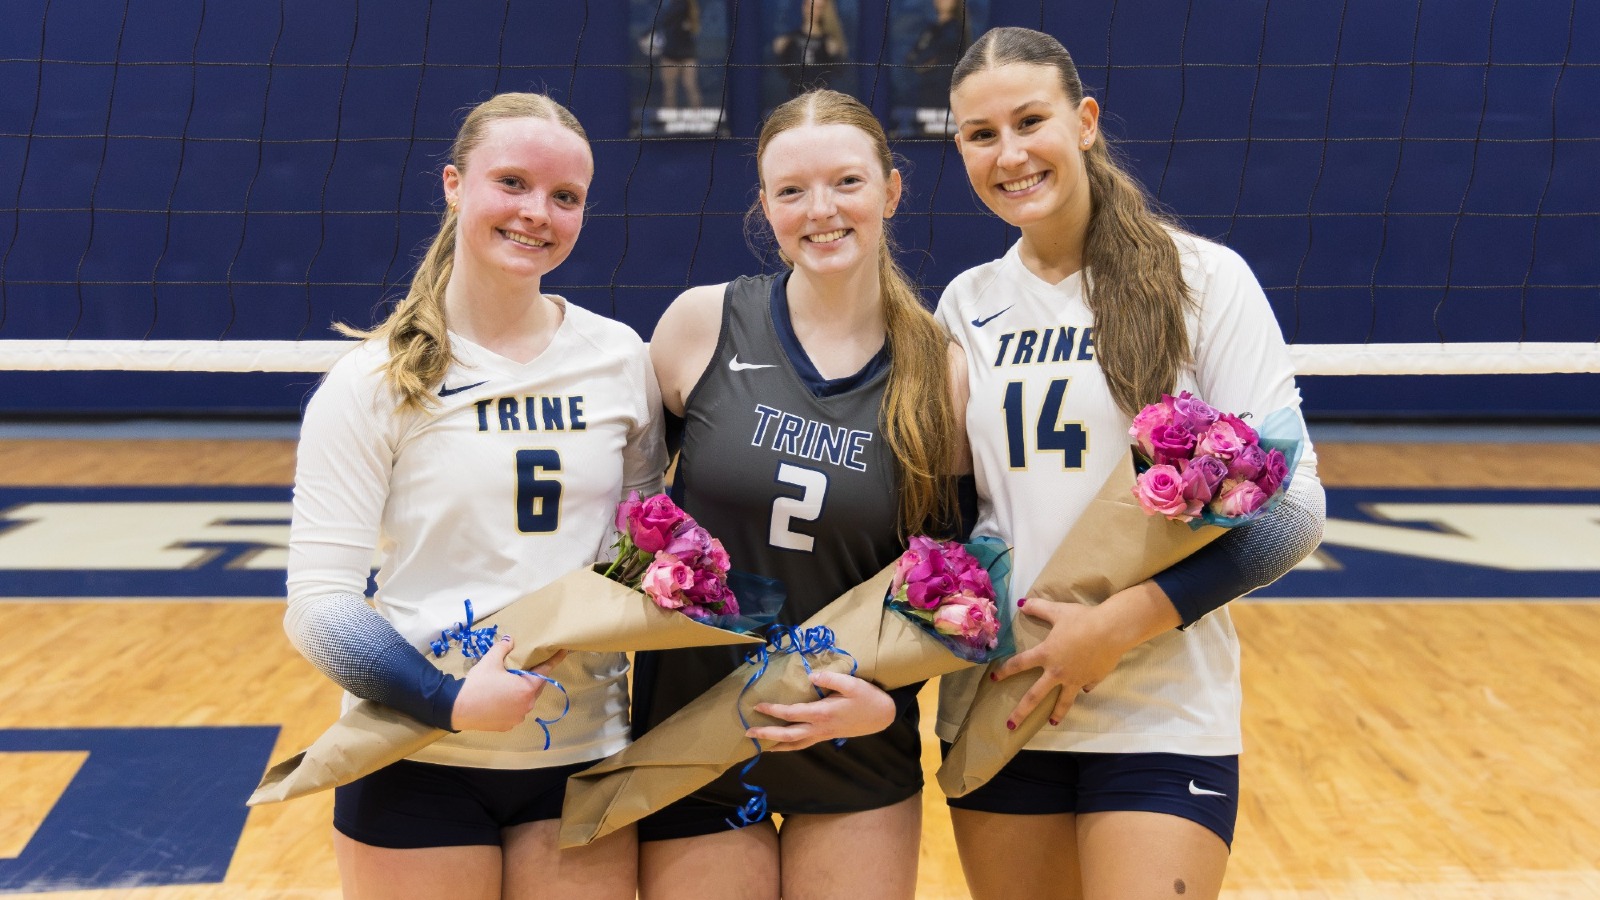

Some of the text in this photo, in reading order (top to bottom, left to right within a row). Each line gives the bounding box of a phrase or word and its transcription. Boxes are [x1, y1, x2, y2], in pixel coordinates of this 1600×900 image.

[992, 326, 1095, 368] TRINE
[474, 395, 588, 432] TRINE
[751, 404, 873, 472] TRINE
[1001, 377, 1089, 471] 14
[514, 447, 564, 535] 6
[768, 461, 829, 553] 2
